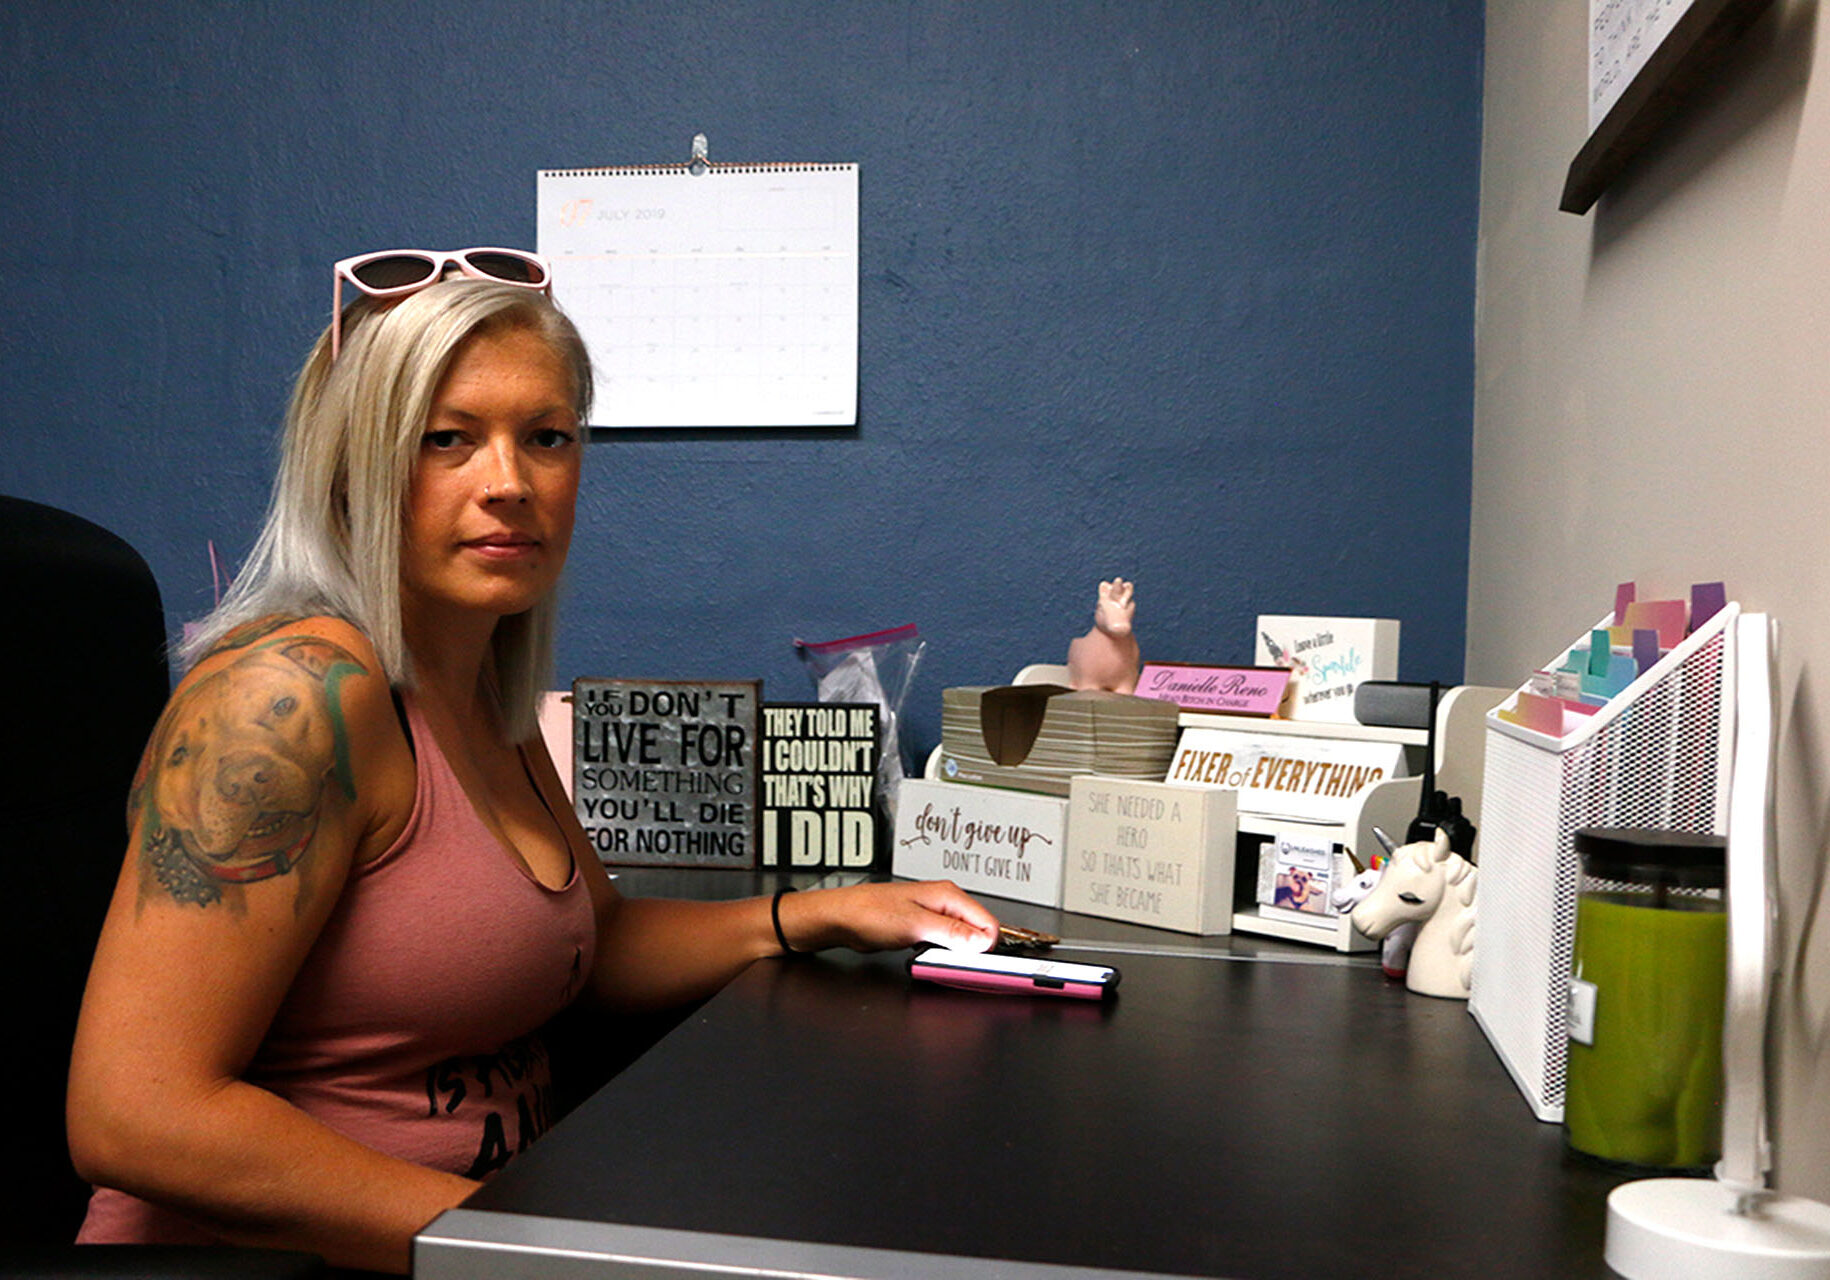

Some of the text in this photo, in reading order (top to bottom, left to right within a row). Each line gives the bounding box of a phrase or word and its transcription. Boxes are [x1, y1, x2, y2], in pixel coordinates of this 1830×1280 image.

[559, 199, 666, 227] 07 JULY 2019
[1150, 669, 1267, 697] Danielle Reno
[585, 690, 745, 718] IF YOU DON'T
[763, 708, 874, 737] THEY TOLD ME
[583, 721, 745, 767] LIVE FOR
[763, 739, 874, 772] I COULDN'T
[582, 768, 744, 795] SOMETHING
[1174, 749, 1233, 785] FIXER
[1229, 767, 1252, 788] of
[763, 774, 873, 808] THAT'S WHY
[582, 798, 744, 824] YOU'LL DIE
[1088, 792, 1182, 822] SHE NEEDED A
[763, 810, 874, 867] I DID
[900, 803, 962, 845] don't
[965, 820, 1007, 850] give
[1116, 826, 1148, 849] HERO
[636, 829, 745, 857] NOTHING
[943, 849, 1031, 882] DON'T GIVE IN
[1081, 850, 1097, 872] SO
[1146, 859, 1183, 886] WHAT
[1089, 882, 1162, 914] SHE BECAME
